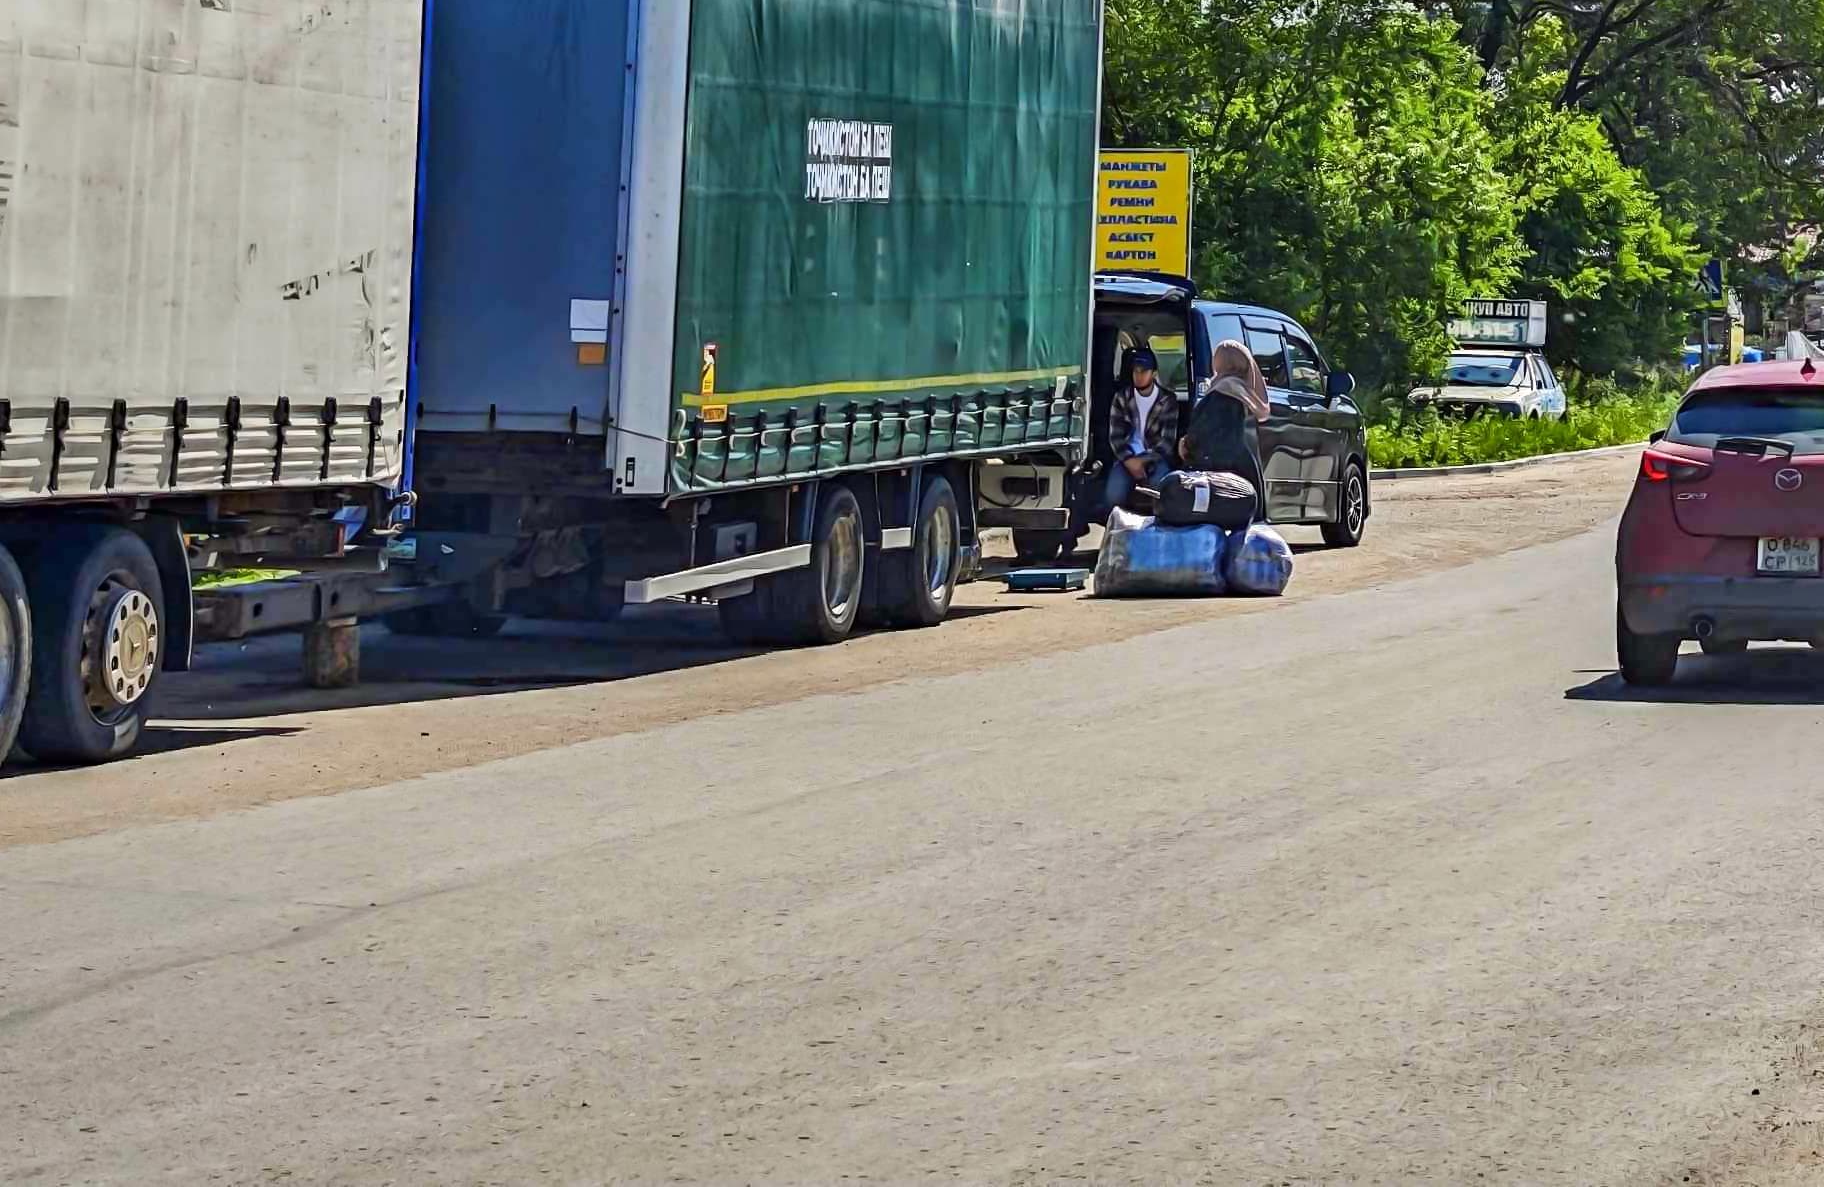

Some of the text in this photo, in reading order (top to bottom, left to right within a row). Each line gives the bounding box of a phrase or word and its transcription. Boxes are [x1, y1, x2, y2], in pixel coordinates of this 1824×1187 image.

[1108, 179, 1157, 189] РУКАВА
[1110, 197, 1155, 207] РЕМНИ
[1496, 301, 1529, 317] АВТО
